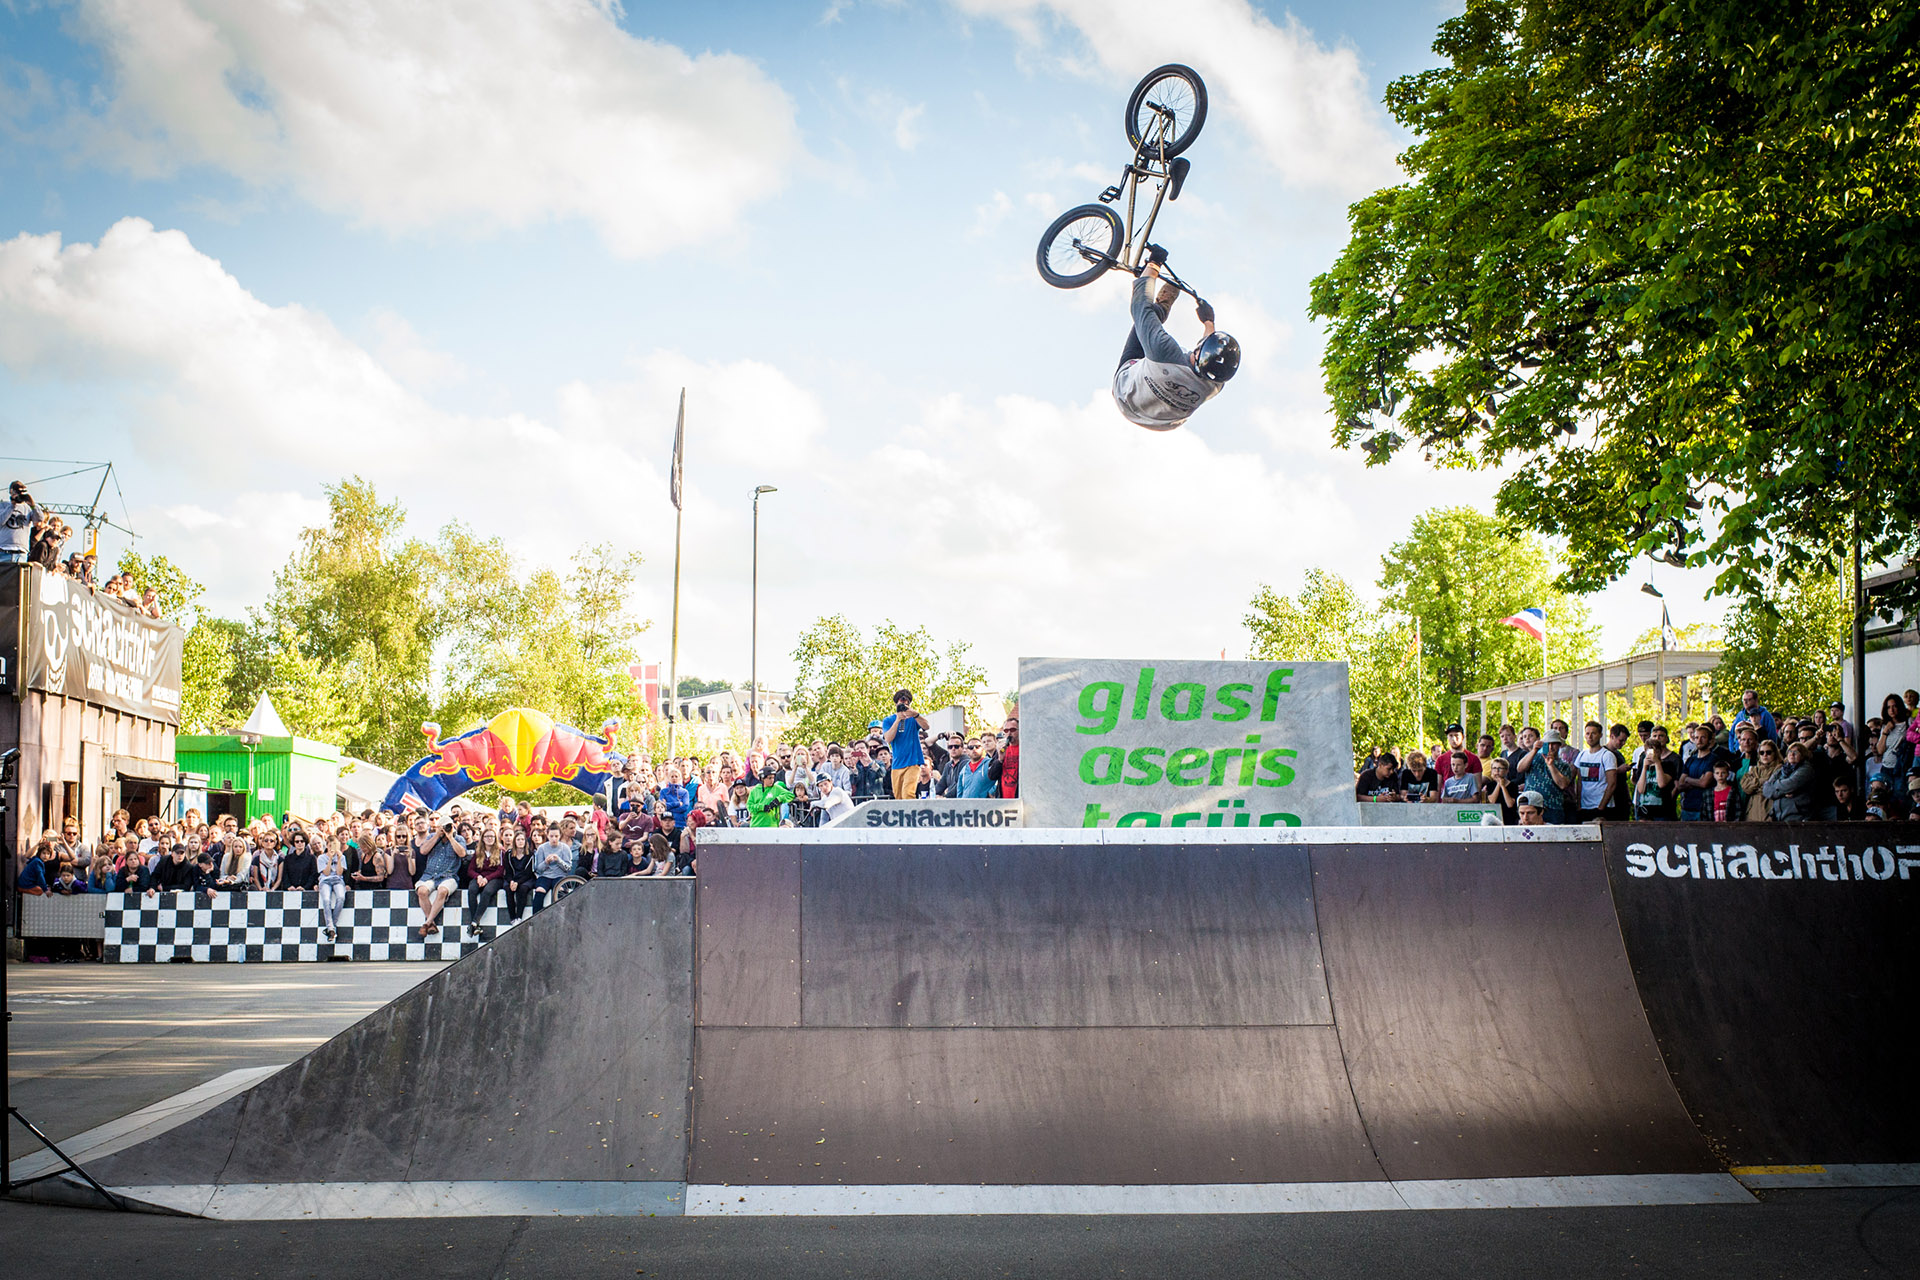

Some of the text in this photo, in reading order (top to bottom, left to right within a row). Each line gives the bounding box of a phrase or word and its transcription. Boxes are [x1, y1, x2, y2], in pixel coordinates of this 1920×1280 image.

[1075, 667, 1294, 735] glasf
[1078, 734, 1298, 787] aseris
[1460, 812, 1480, 821] SKG
